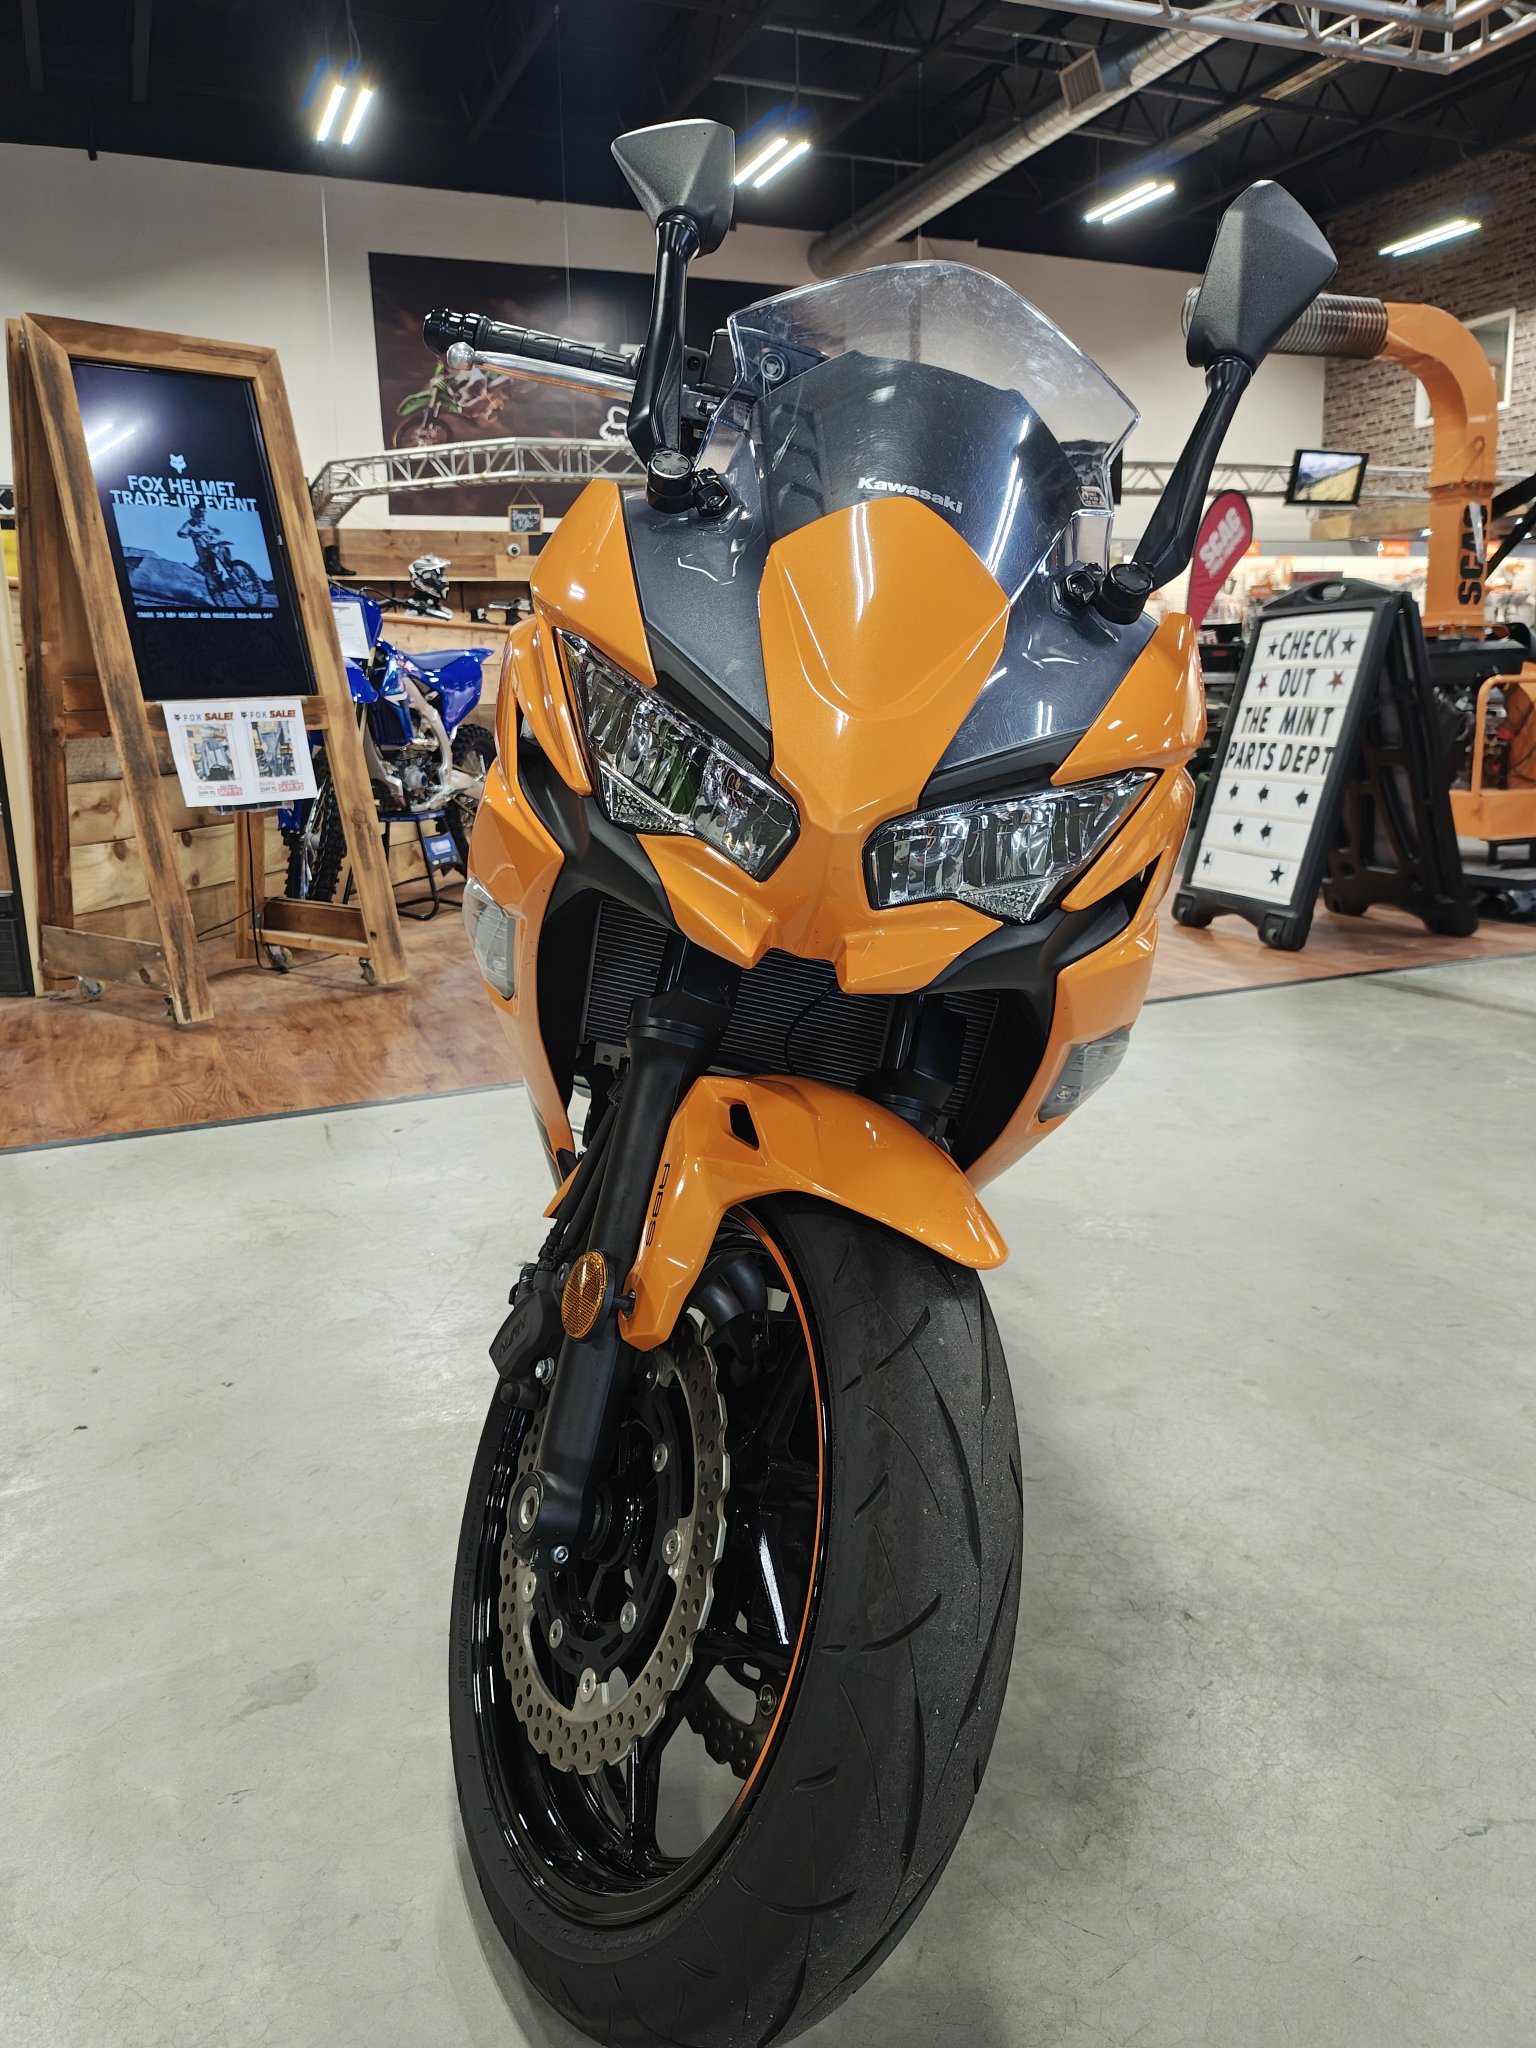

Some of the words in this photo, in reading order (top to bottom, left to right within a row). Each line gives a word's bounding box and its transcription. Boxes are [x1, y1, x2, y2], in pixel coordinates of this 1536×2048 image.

[109, 490, 200, 509] TRADE-UP
[204, 497, 257, 512] EVENT
[127, 475, 166, 493] FOX
[168, 477, 236, 497] HELMET
[857, 477, 964, 514] Kawasaki
[1199, 506, 1241, 571] SCAG
[1278, 628, 1341, 661] CHECK
[1278, 668, 1317, 697] OUT
[204, 711, 233, 721] SALE!
[250, 711, 267, 719] FOX
[269, 709, 296, 719] SALE!
[1241, 706, 1272, 734] THE
[1278, 706, 1336, 737] MINT
[1224, 742, 1277, 771] PARTS
[1278, 743, 1335, 776] DEPT
[645, 1163, 670, 1247] ABS
